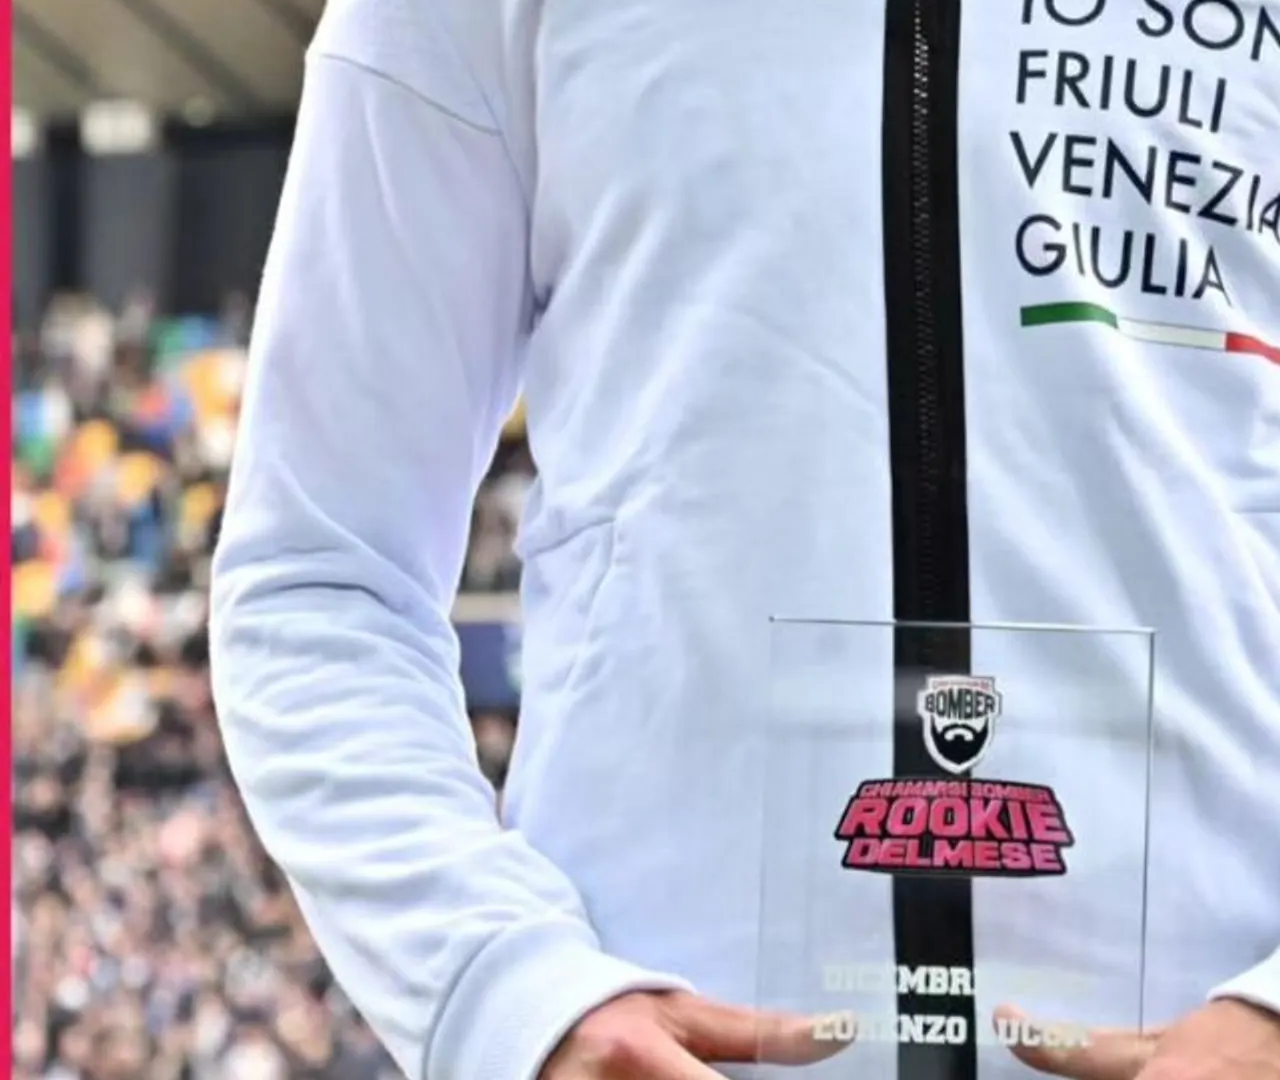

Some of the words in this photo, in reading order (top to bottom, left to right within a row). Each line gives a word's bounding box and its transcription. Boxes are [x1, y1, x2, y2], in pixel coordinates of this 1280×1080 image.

[1016, 49, 1227, 134] FRIULI
[1015, 214, 1233, 308] GIULIA
[925, 687, 995, 719] BOMBER
[838, 797, 1070, 842] ROOKIE
[822, 964, 992, 996] DICMBR
[979, 1016, 1093, 1048] UCCA
